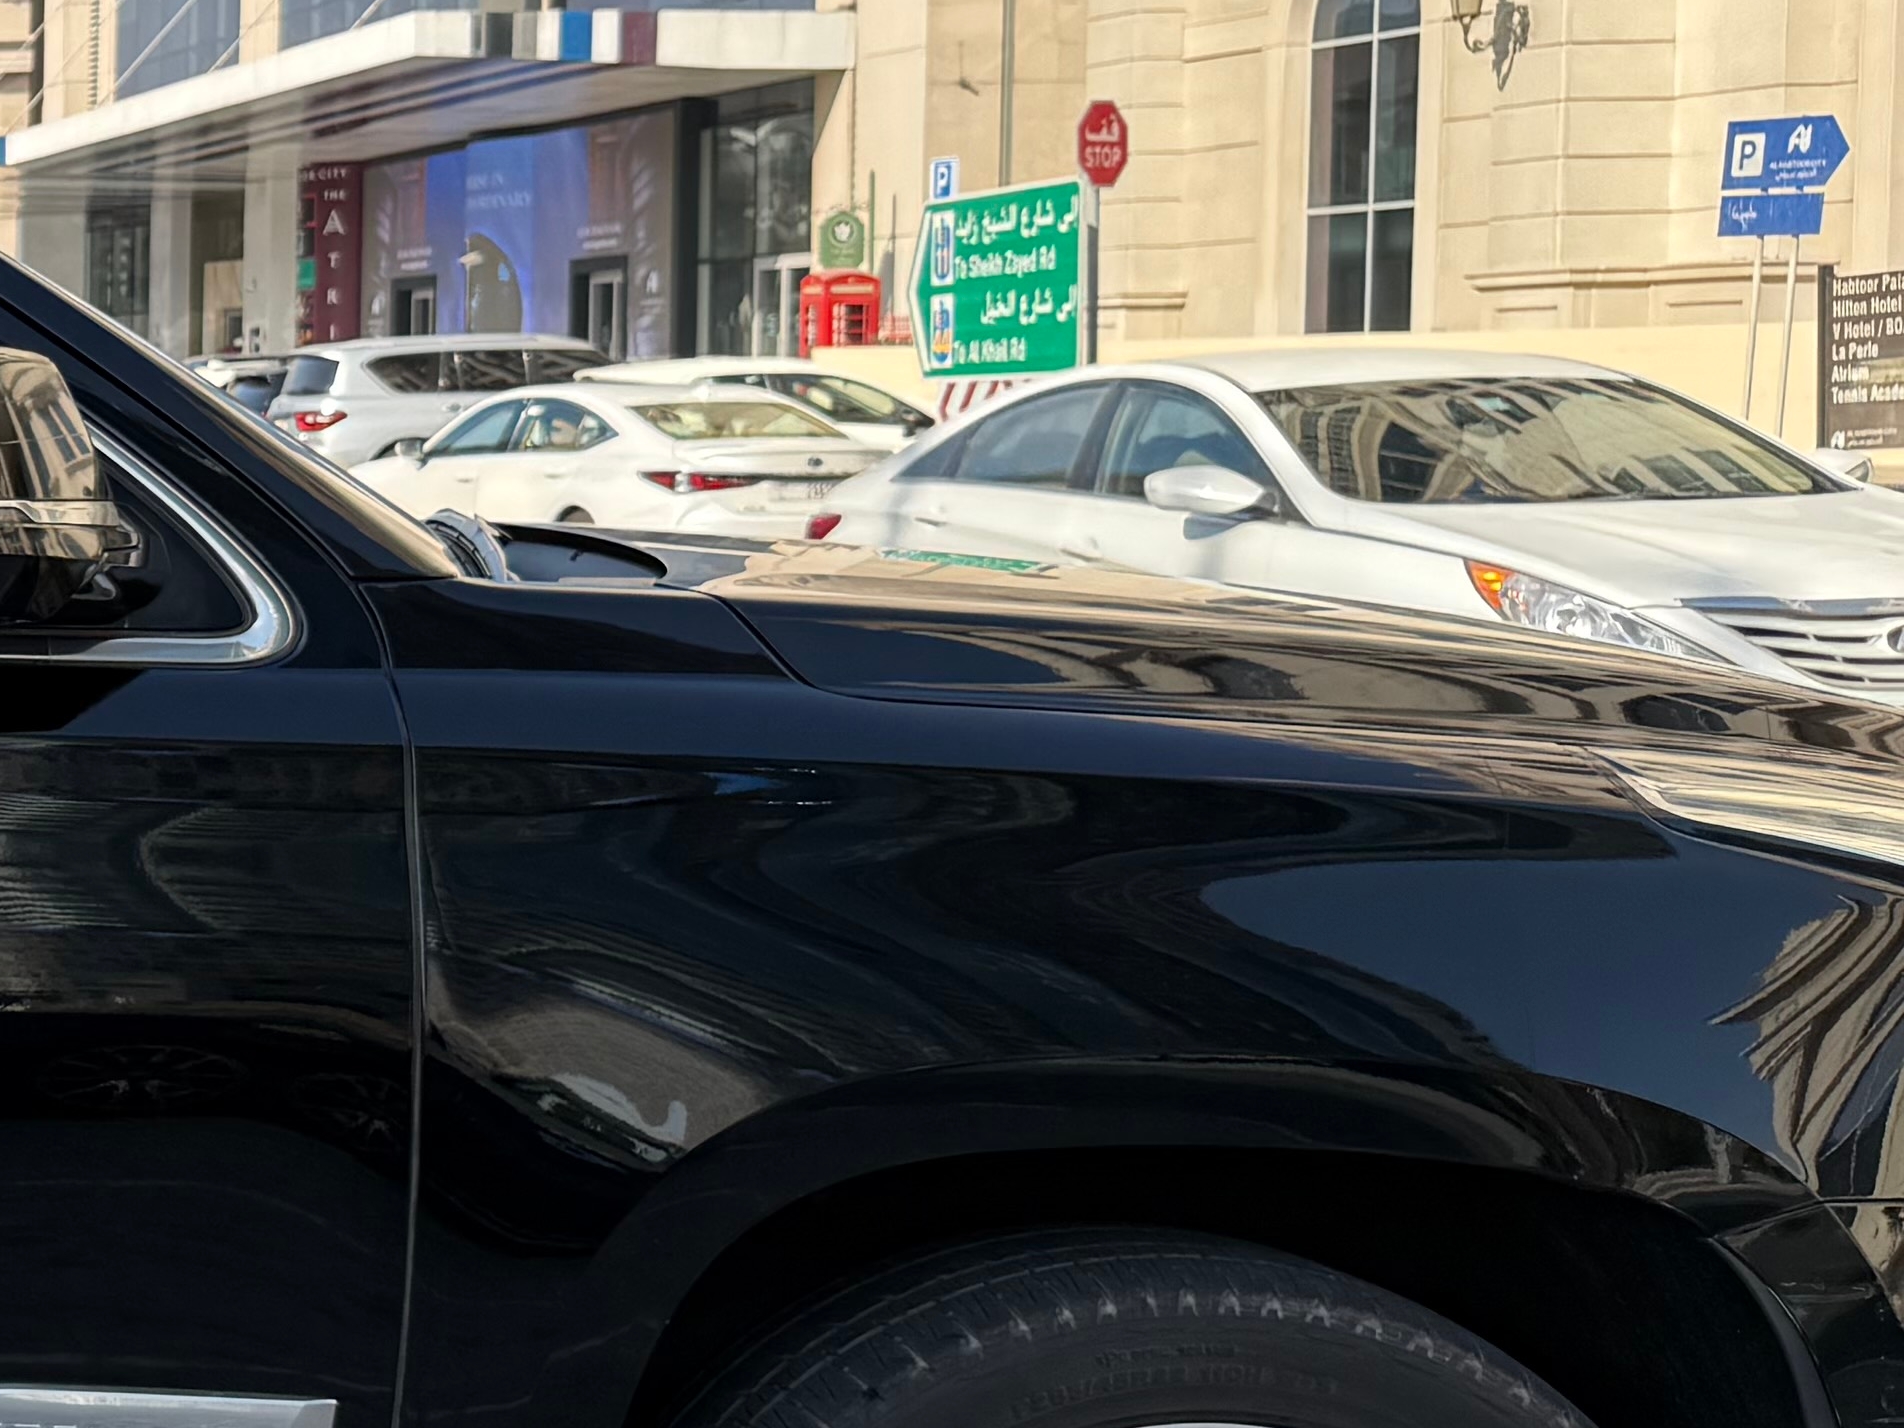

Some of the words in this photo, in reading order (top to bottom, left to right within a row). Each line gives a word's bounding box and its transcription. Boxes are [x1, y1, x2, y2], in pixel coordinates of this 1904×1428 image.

[1085, 113, 1120, 143] قف
[1085, 146, 1122, 169] STOP
[1739, 140, 1756, 171] P
[936, 164, 949, 190] P
[324, 189, 347, 202] THE
[955, 209, 979, 245] زايد
[981, 203, 1018, 245] الشيخ
[1020, 198, 1056, 238] شارع
[954, 256, 967, 280] To
[968, 252, 1003, 279] Sheikh
[1004, 247, 1037, 278] Zayed
[1038, 244, 1057, 271] Rd
[1832, 277, 1879, 297] Habtoor
[980, 289, 1017, 326] الخيل
[1019, 287, 1054, 326] شارع
[1832, 299, 1868, 318] Hilton
[1870, 294, 1903, 315] Hotel
[1832, 323, 1841, 341] V
[1844, 320, 1875, 340] Hotel
[1886, 316, 1904, 336] BO
[953, 340, 967, 365] To
[968, 340, 981, 364] Al
[981, 337, 1010, 363] Khail
[1010, 336, 1028, 362] Rd
[1832, 343, 1846, 362] La
[1848, 341, 1879, 360] Perle
[1831, 364, 1871, 384] Atrium
[1831, 387, 1868, 405] Tennis
